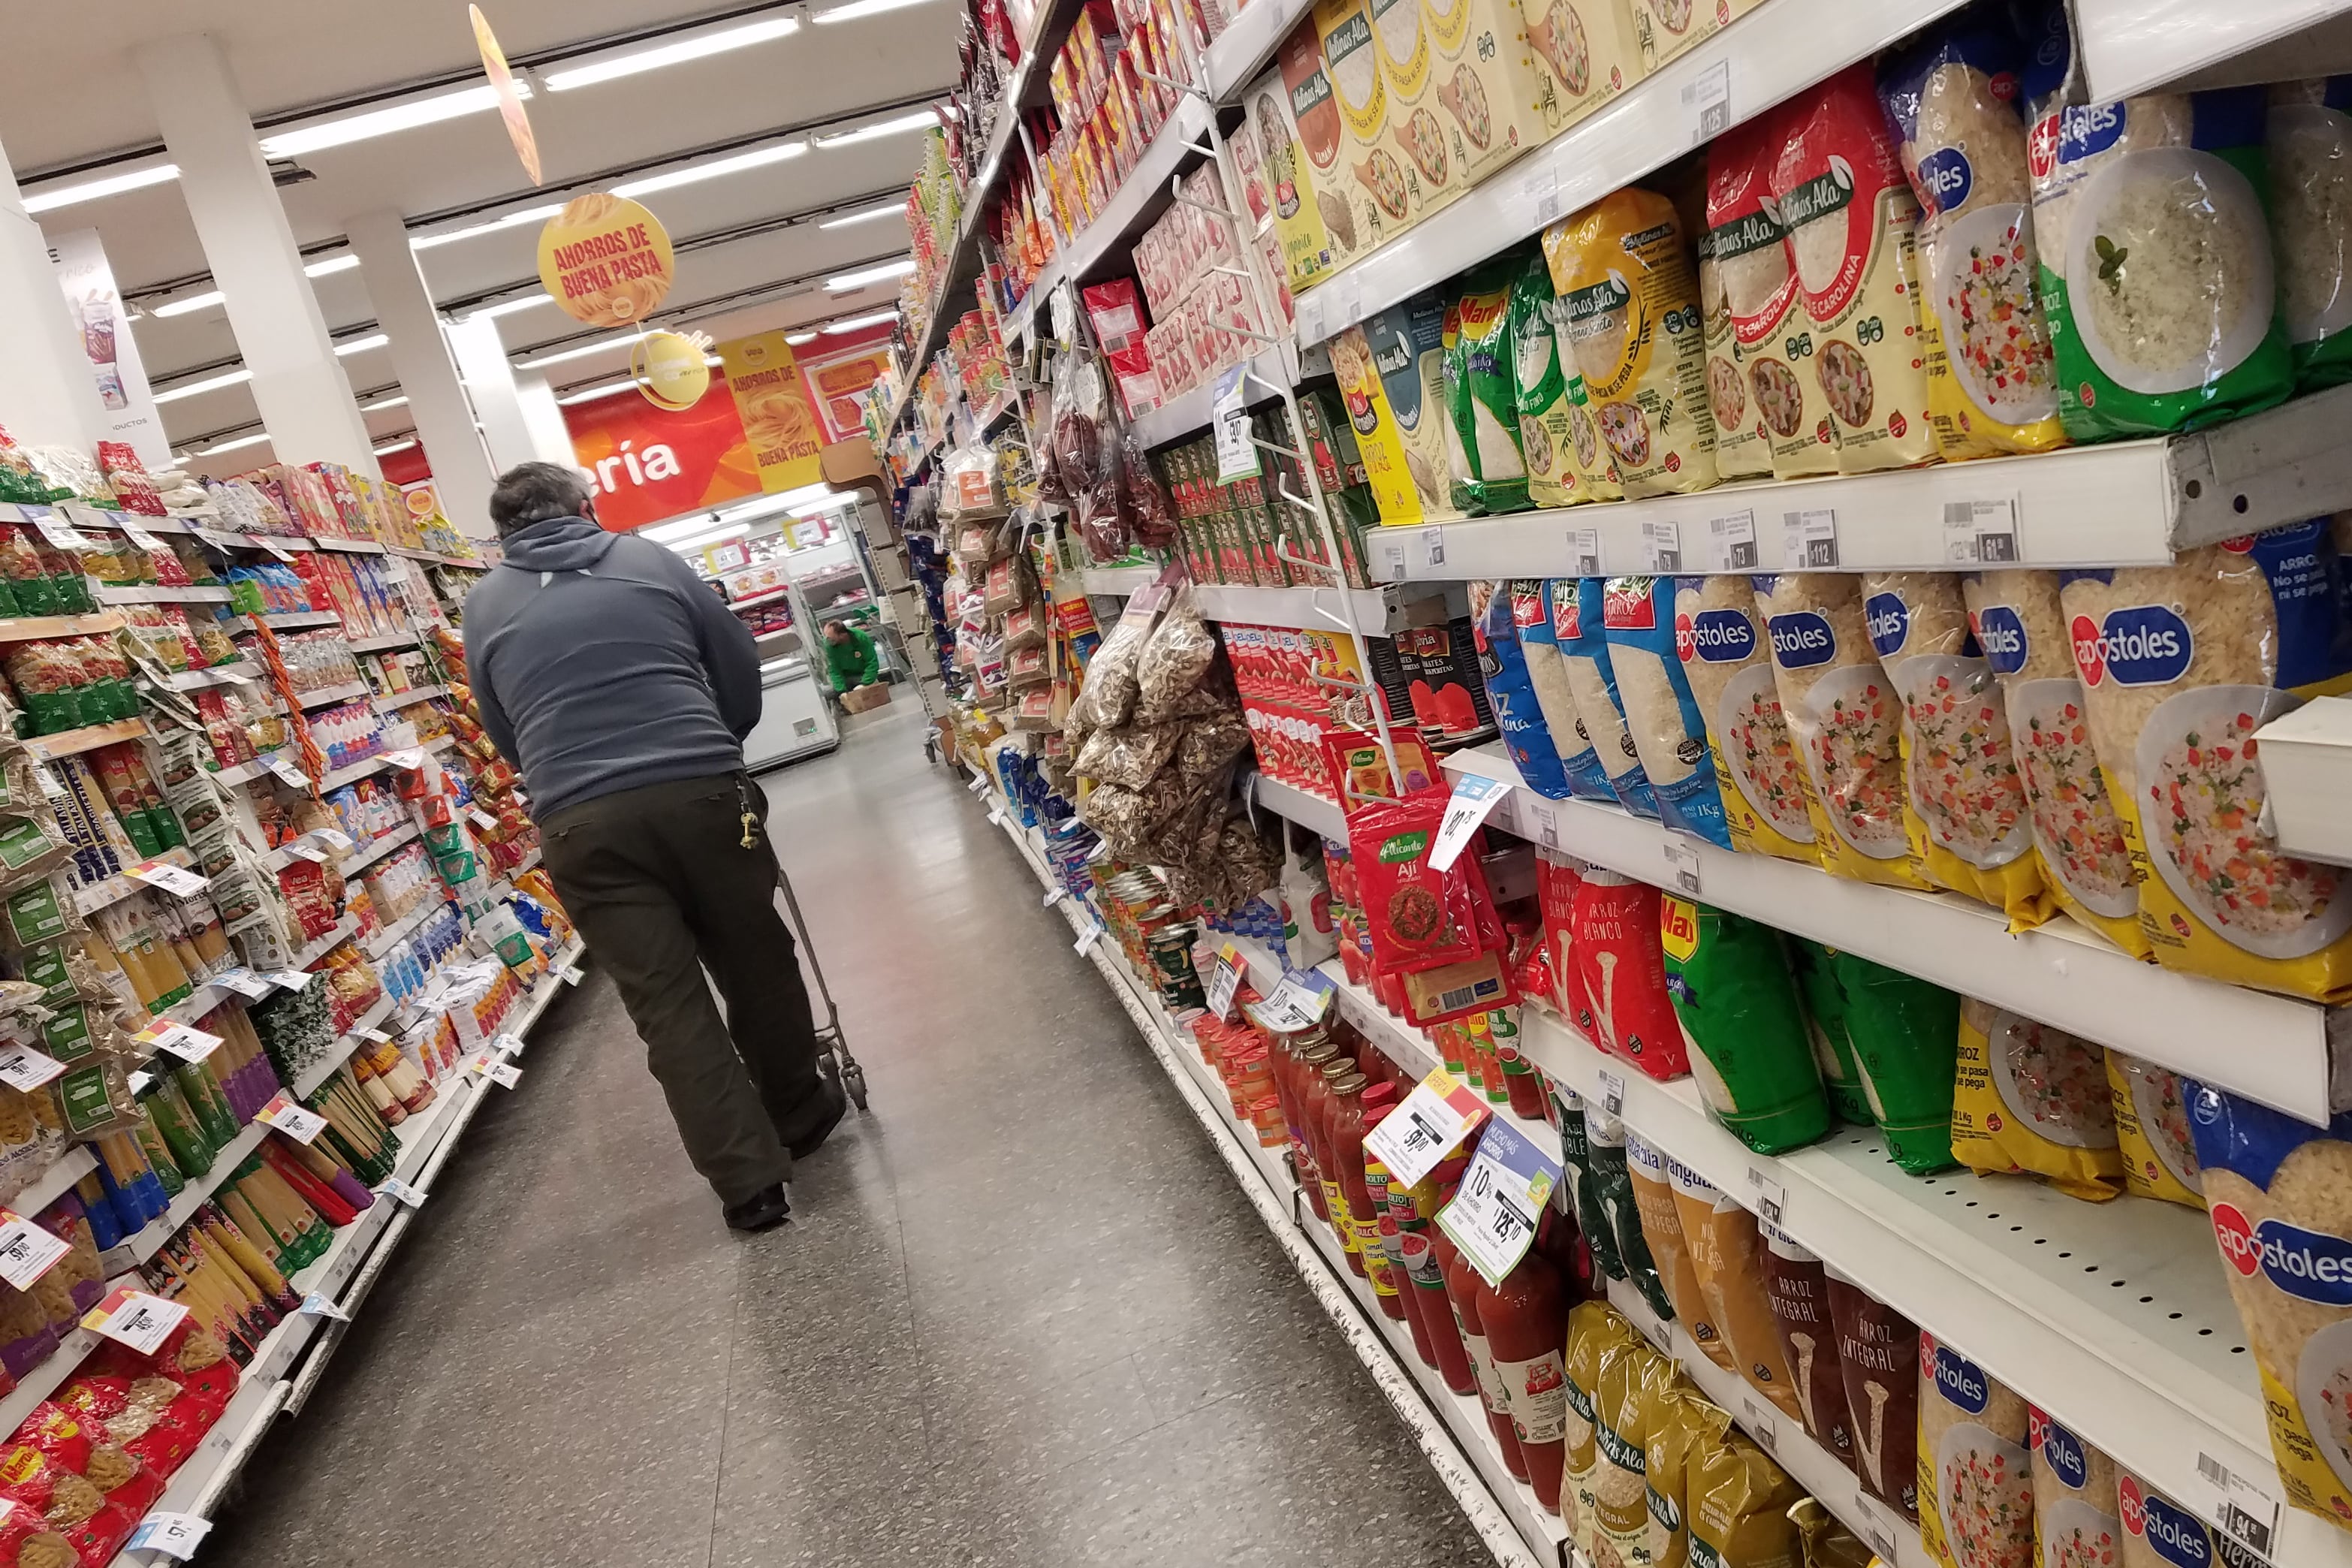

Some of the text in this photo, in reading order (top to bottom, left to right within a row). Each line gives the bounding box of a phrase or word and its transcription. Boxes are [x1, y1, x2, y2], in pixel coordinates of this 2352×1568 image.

[1812, 178, 1841, 208] Ala
[1742, 218, 1775, 247] Ala
[552, 222, 651, 273] AHORROS DE
[559, 249, 662, 301] BUENA PASTA
[1817, 255, 1862, 315] CAROLINA
[733, 366, 779, 394] AHORROS
[779, 363, 795, 381] DE
[113, 417, 148, 432] DUCTOS
[757, 440, 819, 469] BUENA PASTA
[2278, 553, 2316, 572] ARRO
[1771, 626, 1829, 653] stoles
[2075, 624, 2180, 673] apóstoles
[1698, 802, 1720, 819] 1Kg
[1380, 840, 1425, 859] Alicante
[1397, 860, 1417, 879] Ají
[1588, 901, 1619, 918] ARROZ
[1583, 921, 1622, 940] BLANCO
[1965, 1078, 1986, 1090] pega
[1968, 1067, 1989, 1079] pasa
[1481, 1138, 1504, 1161] AHORRO
[1488, 1123, 1519, 1156] MUCHO MÁS
[1624, 1132, 1660, 1171] nguardia
[1389, 1194, 1404, 1204] OLTO
[2218, 1222, 2352, 1283] apóstoles
[1778, 1277, 1814, 1298] ARROZ
[1769, 1292, 1820, 1322] INTEGRAL
[1859, 1318, 1893, 1343] ARROZ
[1842, 1334, 1896, 1373] INTEGRAL
[1922, 1341, 1983, 1402] apóstoles
[1620, 1442, 1646, 1470] Ala
[1654, 1499, 1670, 1526] Ala
[2122, 1497, 2204, 1560] apóstoles
